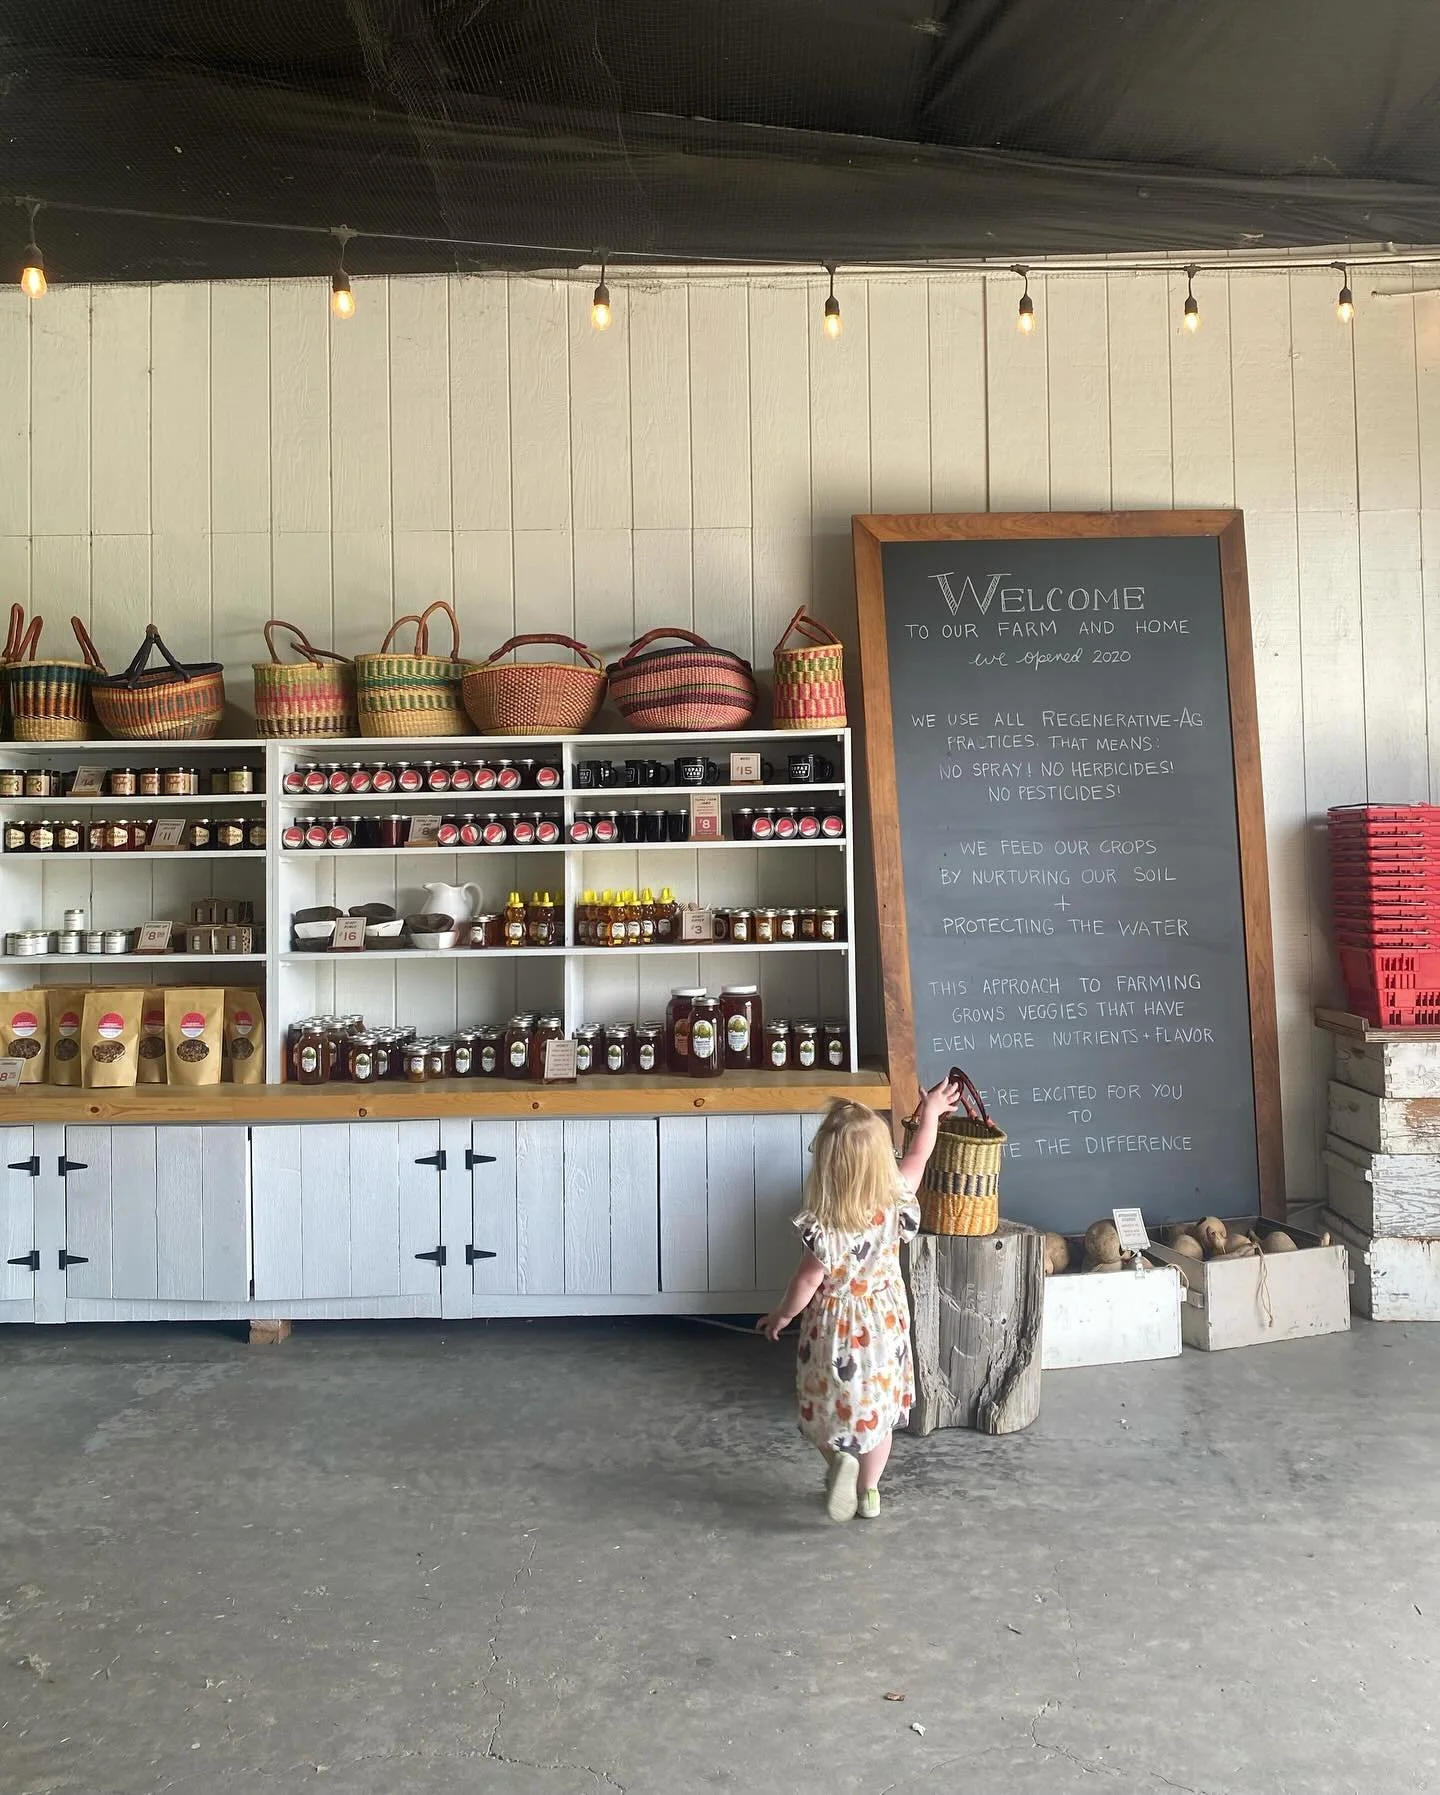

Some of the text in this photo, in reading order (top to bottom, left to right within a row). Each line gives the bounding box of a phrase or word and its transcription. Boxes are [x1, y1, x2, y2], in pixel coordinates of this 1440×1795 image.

[928, 572, 1145, 616] WELCOME
[905, 619, 1190, 639] TO OUR FARM AND HOME
[1016, 647, 1083, 671] opened
[1092, 650, 1131, 663] 2020
[911, 713, 936, 728] WE
[948, 712, 980, 726] USE
[994, 711, 1025, 726] ALL
[1049, 735, 1089, 751] THAT
[1096, 736, 1160, 751] MEANS:
[939, 759, 1175, 780] NO SPRAY! NO HERBICIDES!
[988, 783, 1122, 802] NO PESTICIDES!
[960, 839, 1158, 856] WE FEED OUR CROPS
[941, 866, 1177, 886] BY NURTURING OUR SOIL
[1053, 893, 1071, 912] +
[942, 916, 1189, 937] PROTECTING THE WATER
[928, 973, 1201, 996] THIS APPROACH TO FARMING
[952, 1001, 1185, 1024] GROWS VEGGIES THAT HAVE
[932, 1034, 976, 1052] EVEN
[989, 1032, 1035, 1049] MORE
[1052, 1029, 1139, 1047] NUTRIENTS
[1154, 1026, 1215, 1043] FLAVOR
[1032, 1084, 1097, 1102] EXCITED
[1107, 1084, 1142, 1100] FOR
[1151, 1082, 1184, 1101] YOU
[1067, 1108, 1092, 1124] TO
[1035, 1138, 1072, 1155] THE
[1085, 1134, 1194, 1154] DIFFERENCE
